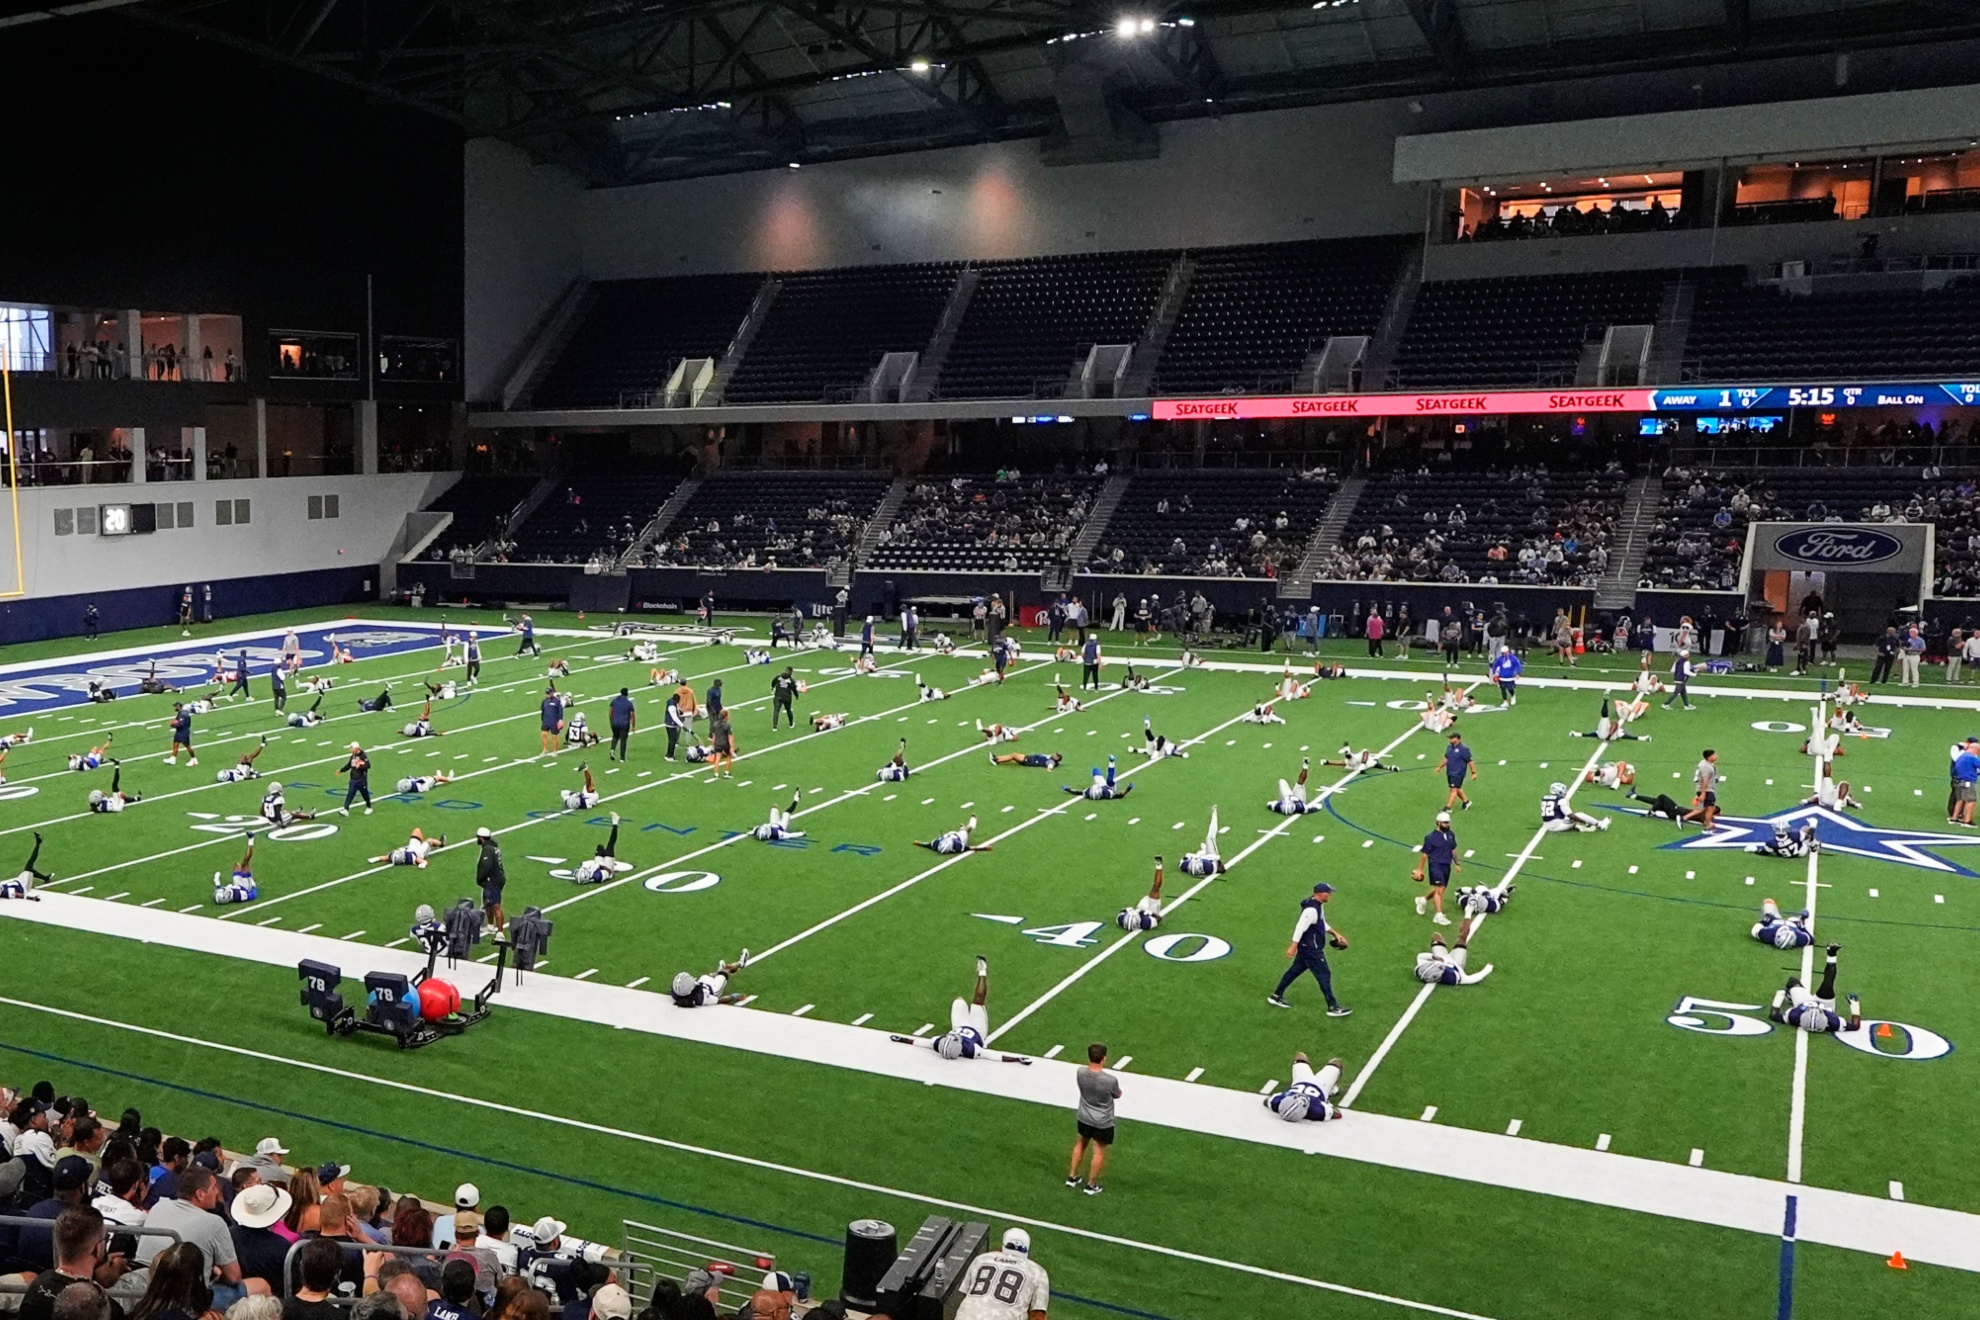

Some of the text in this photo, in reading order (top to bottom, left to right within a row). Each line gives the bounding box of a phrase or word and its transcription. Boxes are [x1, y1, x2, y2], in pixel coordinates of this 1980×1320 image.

[1663, 390, 1732, 407] AWAY 1
[1737, 389, 1758, 398] TOL
[1788, 388, 1835, 405] 5:15
[1843, 388, 1862, 396] QTR
[1965, 394, 1974, 402] 0
[1292, 399, 1358, 413] SEATGEEK
[1416, 397, 1487, 411] SEATGEEK
[1548, 393, 1625, 408] SEATGEEK
[1741, 398, 1750, 407] 0
[1847, 396, 1856, 405] 0
[1176, 403, 1238, 415] SEATGEEK
[105, 508, 125, 531] 20
[1799, 532, 1877, 561] Ford
[812, 604, 833, 617] Lite
[1020, 920, 1232, 962] 40
[308, 975, 325, 992] 78
[375, 987, 394, 1002] 78
[969, 1264, 1025, 1305] 88
